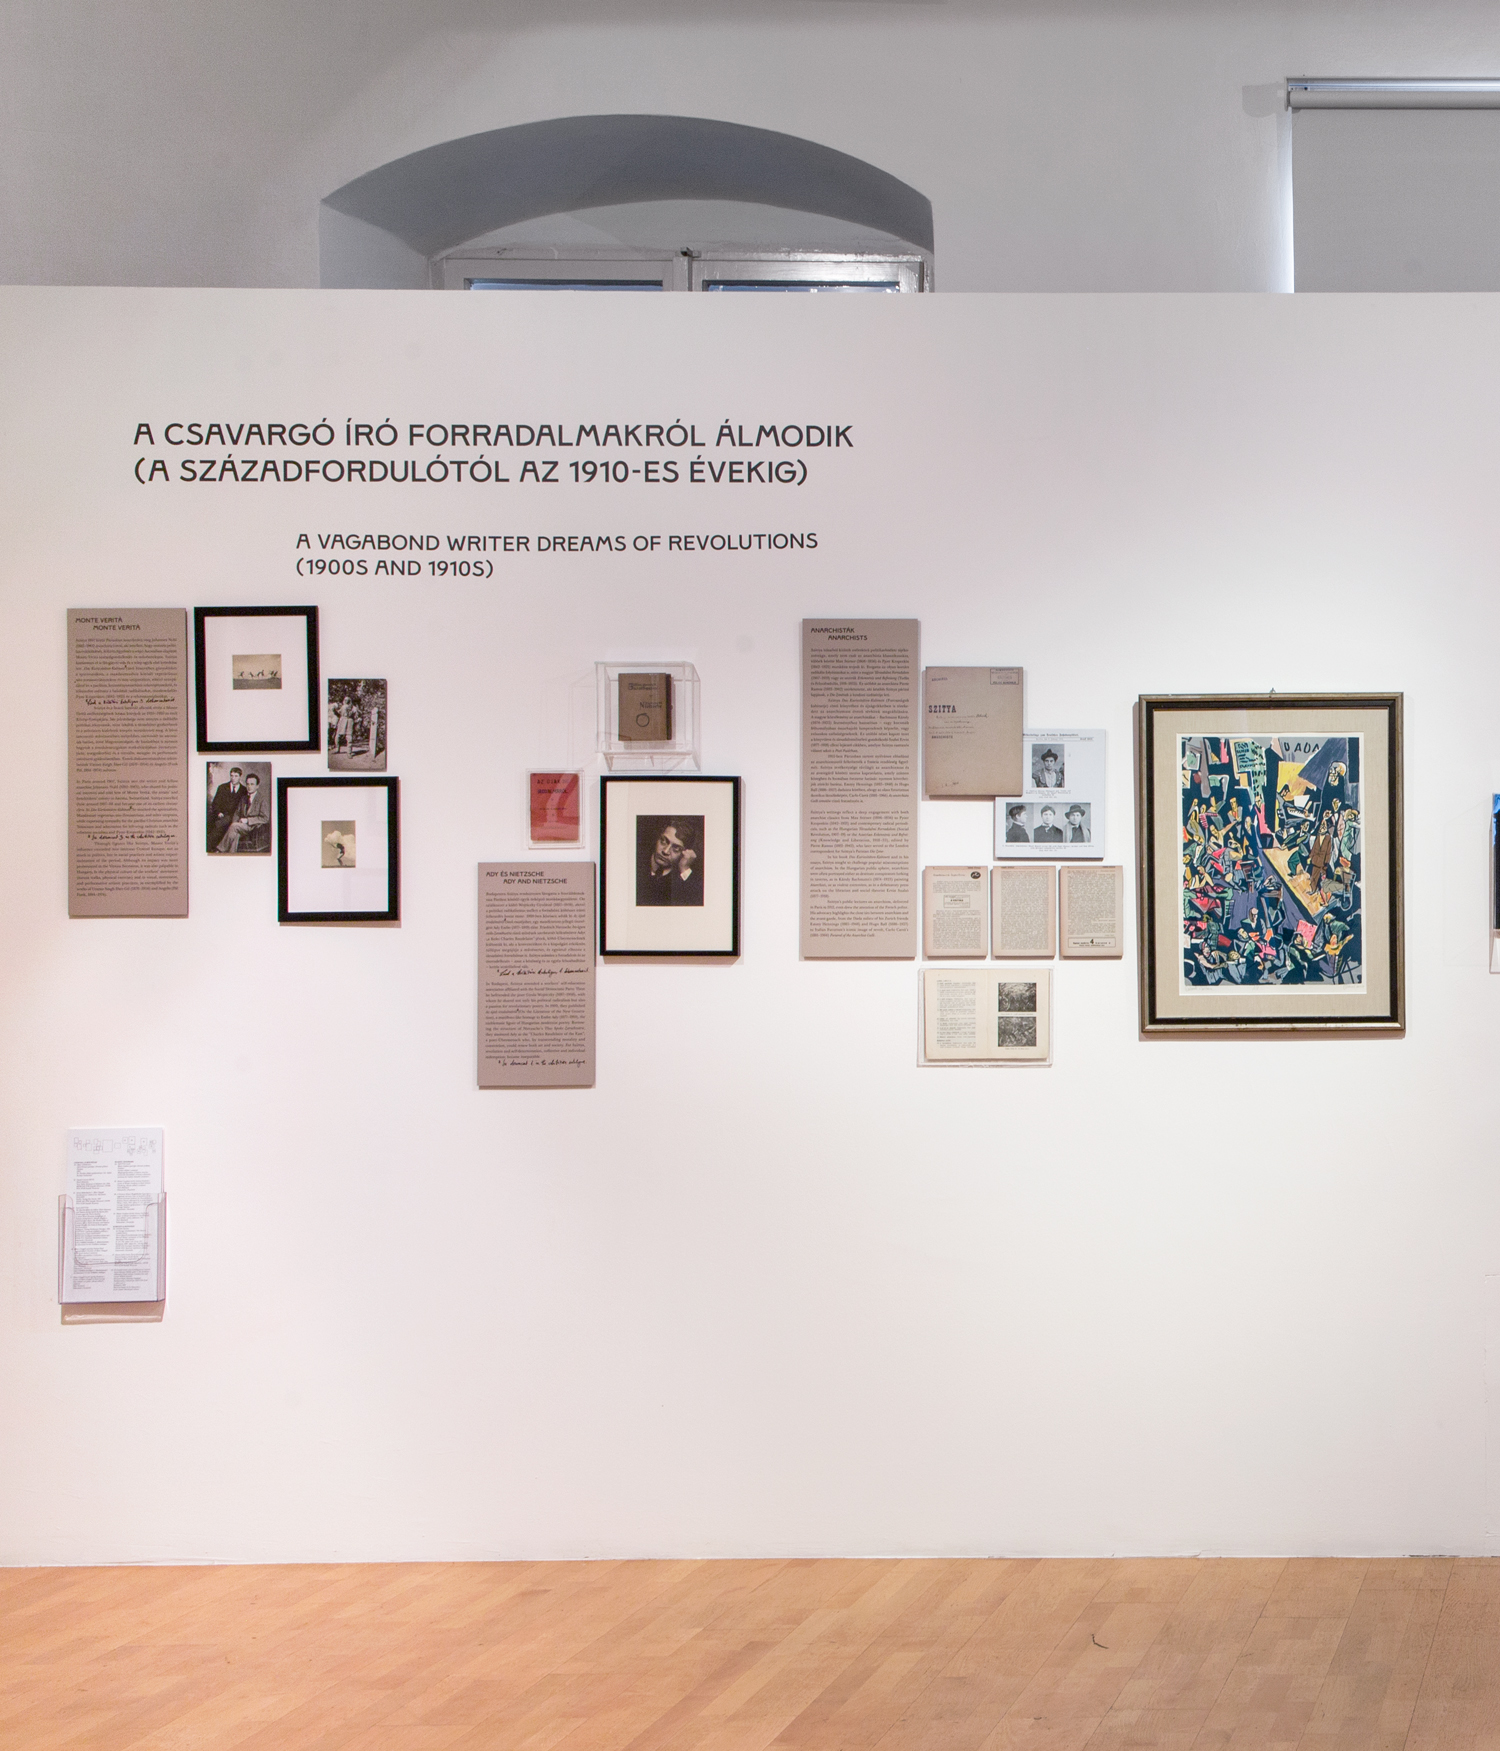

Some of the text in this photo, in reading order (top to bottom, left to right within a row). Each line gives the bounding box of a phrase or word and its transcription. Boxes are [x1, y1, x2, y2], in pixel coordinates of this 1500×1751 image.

[132, 416, 854, 448] A CSAVARGÓ ÍRÓ FORRADALMAKRÓL ÁLMODIK
[133, 453, 808, 487] (A SZÁZADFORDULÓTÓL AZ 1910-ES ÉVEKIG)
[295, 532, 819, 553] A VAGABOND WRITER DREAMS OF REVOLUTIONS
[295, 556, 494, 580] (1900S AND 1910S)
[927, 705, 957, 714] SZITYA
